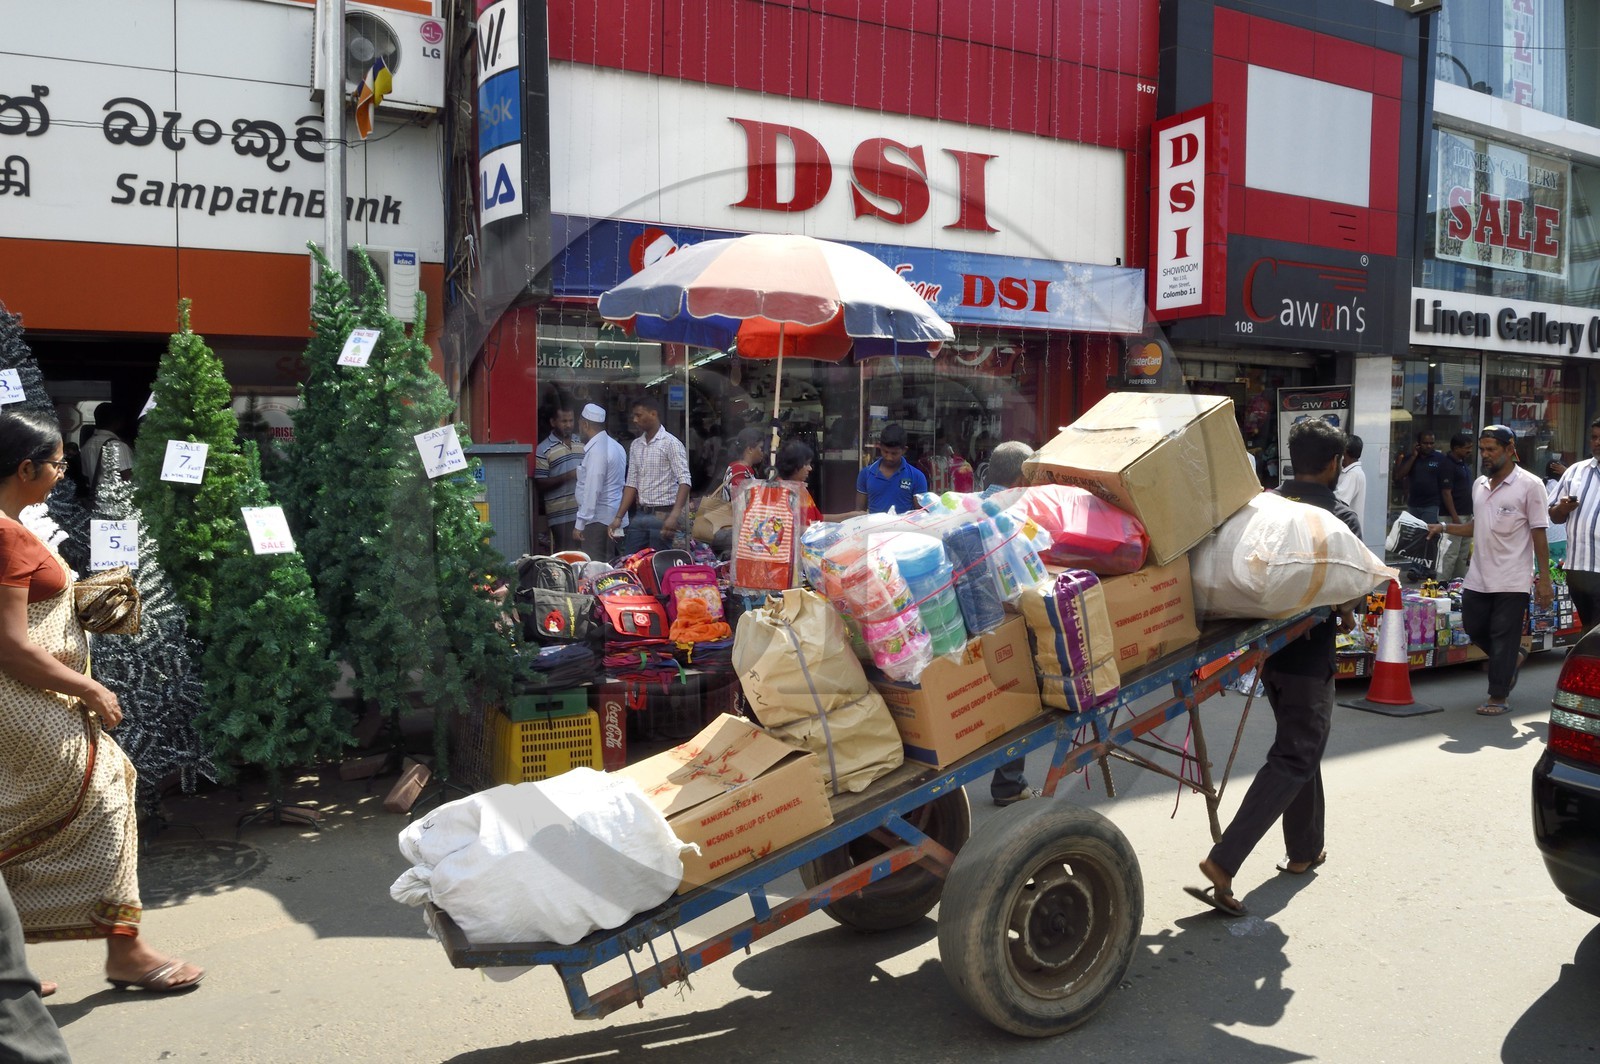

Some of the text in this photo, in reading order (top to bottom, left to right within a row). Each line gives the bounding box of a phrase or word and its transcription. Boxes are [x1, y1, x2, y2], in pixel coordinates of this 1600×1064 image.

[422, 46, 441, 59] LG
[727, 117, 1001, 233] DSI
[1453, 146, 1560, 191] LINEN GALLERY
[111, 173, 402, 225] SampathBnk
[1167, 132, 1200, 260] DSI
[1448, 185, 1560, 258] SALE
[1162, 262, 1199, 277] SHOWROOM
[960, 273, 1052, 313] DSI
[1162, 287, 1196, 299] Colombo 11
[1234, 321, 1254, 334] 108
[1415, 298, 1491, 338] Linen
[1497, 307, 1585, 355] Gallery
[343, 355, 362, 363] SALE
[423, 428, 449, 442] SALE
[176, 443, 201, 451] SALE
[433, 444, 445, 459] 7
[180, 455, 191, 468] 7
[100, 523, 128, 531] SALE
[109, 535, 121, 549] 5
[260, 541, 286, 550] SALE
[946, 677, 984, 701] MANUFACTURED
[950, 703, 971, 720] MCSONS
[970, 695, 986, 710] GROUP
[986, 692, 994, 701] OF
[706, 797, 802, 848] MCSONS GROUP OF COMPANIES.
